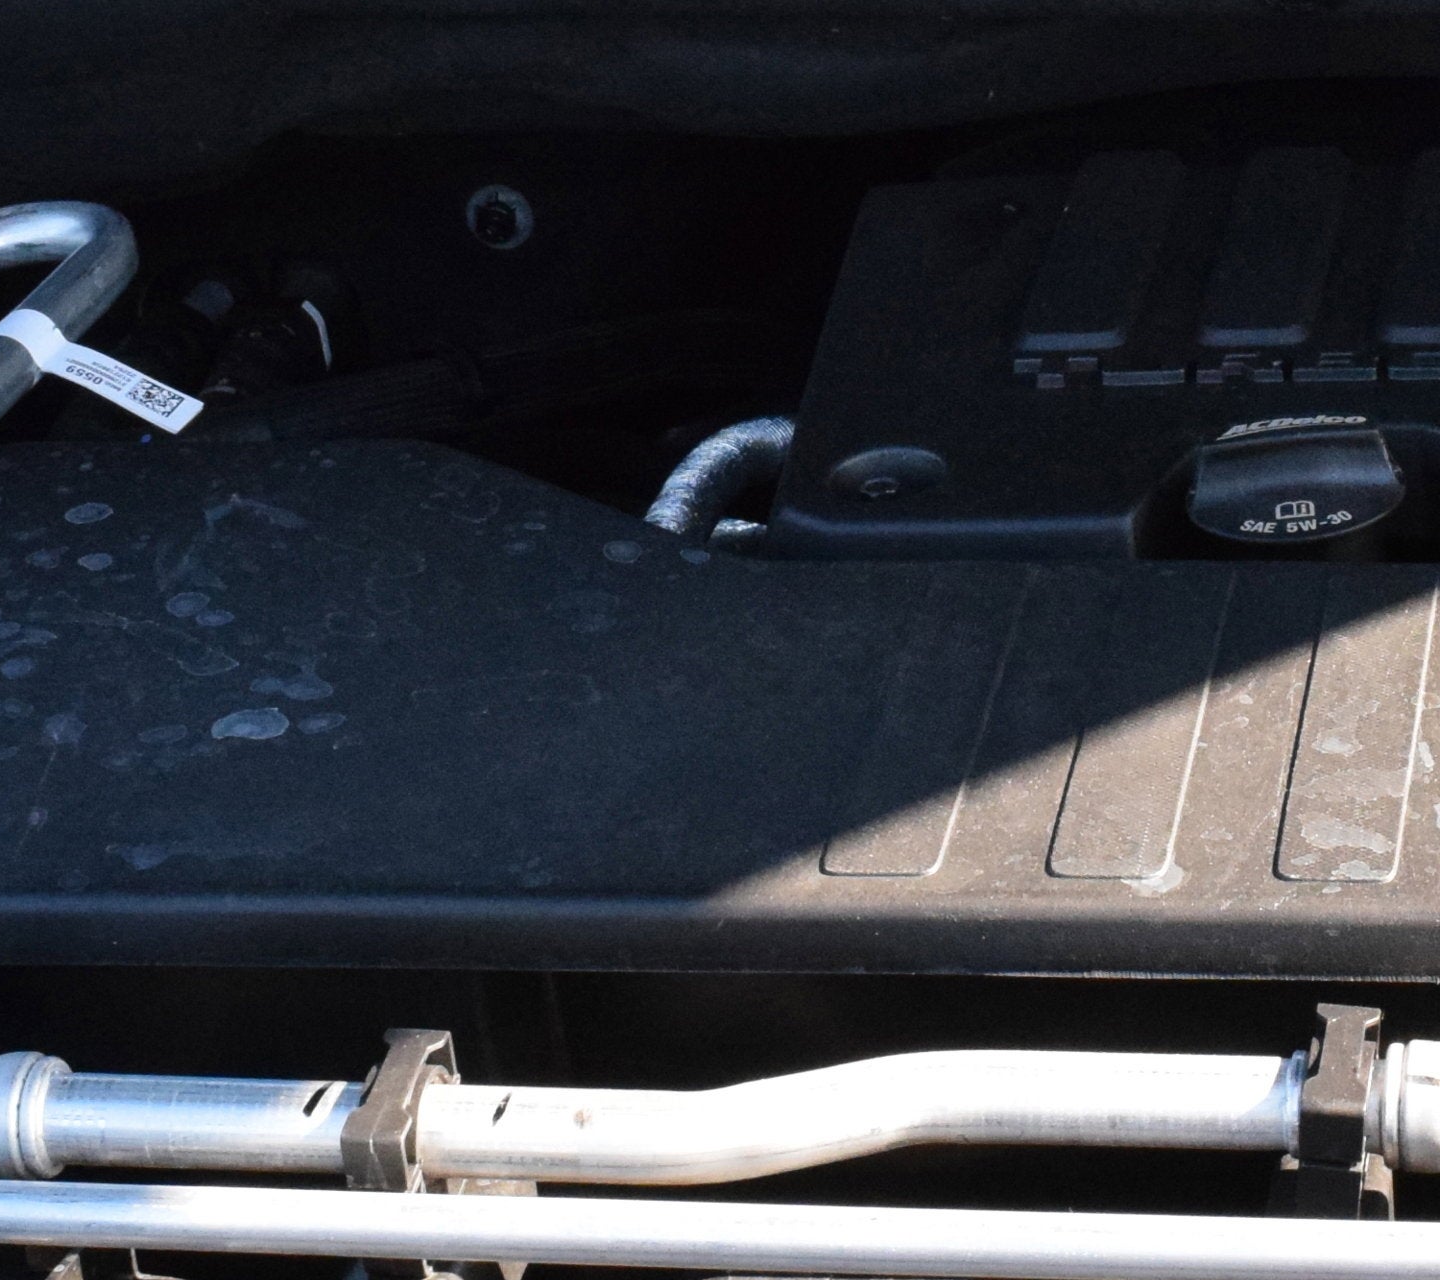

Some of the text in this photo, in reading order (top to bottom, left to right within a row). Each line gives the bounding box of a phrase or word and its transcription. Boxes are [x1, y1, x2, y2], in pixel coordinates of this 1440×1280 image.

[66, 365, 103, 385] 0559
[1219, 415, 1367, 439] ACDelco
[1240, 510, 1353, 534] SAE 5W-30
